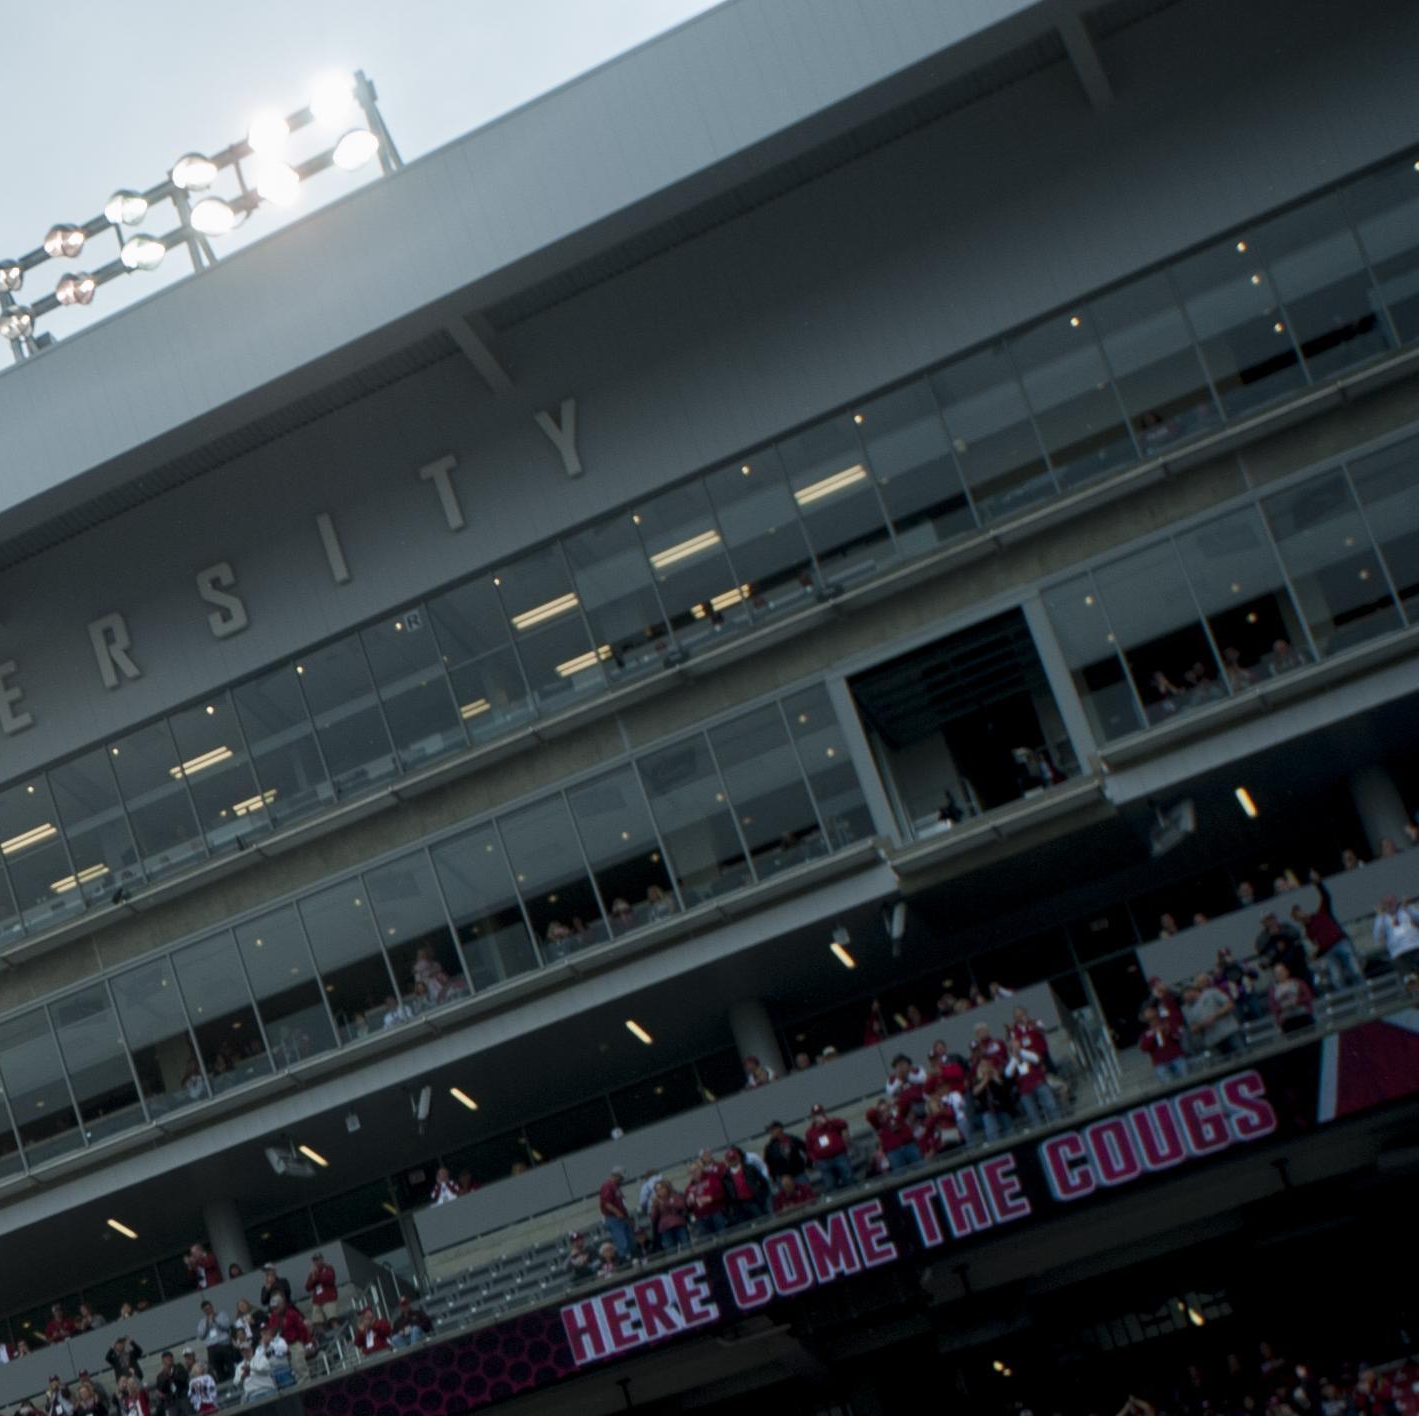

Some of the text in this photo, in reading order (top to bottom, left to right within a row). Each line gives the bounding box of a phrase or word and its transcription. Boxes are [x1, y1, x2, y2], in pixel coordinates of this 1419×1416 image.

[560, 1068, 1278, 1368] HERE COME THE COUGS
